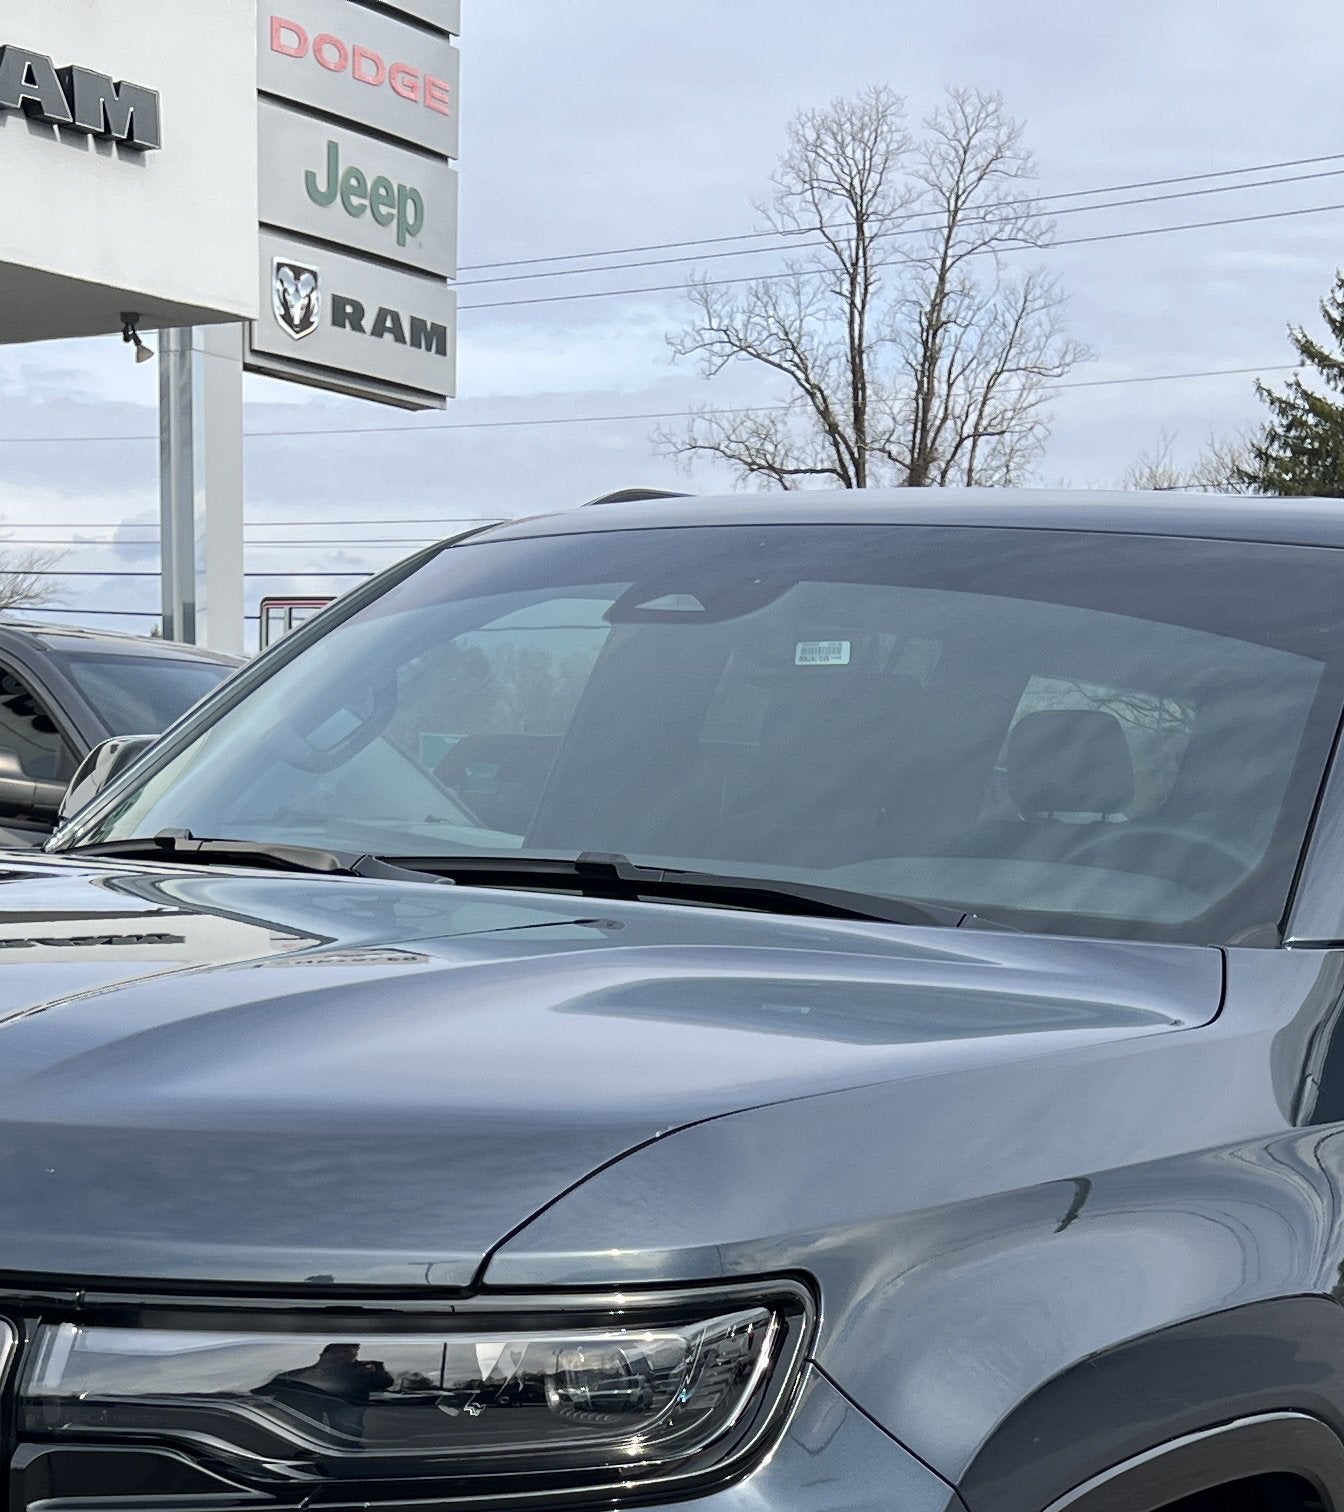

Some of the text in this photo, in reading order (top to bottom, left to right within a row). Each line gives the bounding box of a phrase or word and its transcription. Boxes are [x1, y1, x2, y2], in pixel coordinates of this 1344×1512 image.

[270, 15, 451, 117] DODGE
[305, 139, 425, 247] Jeep
[330, 293, 448, 357] RAM
